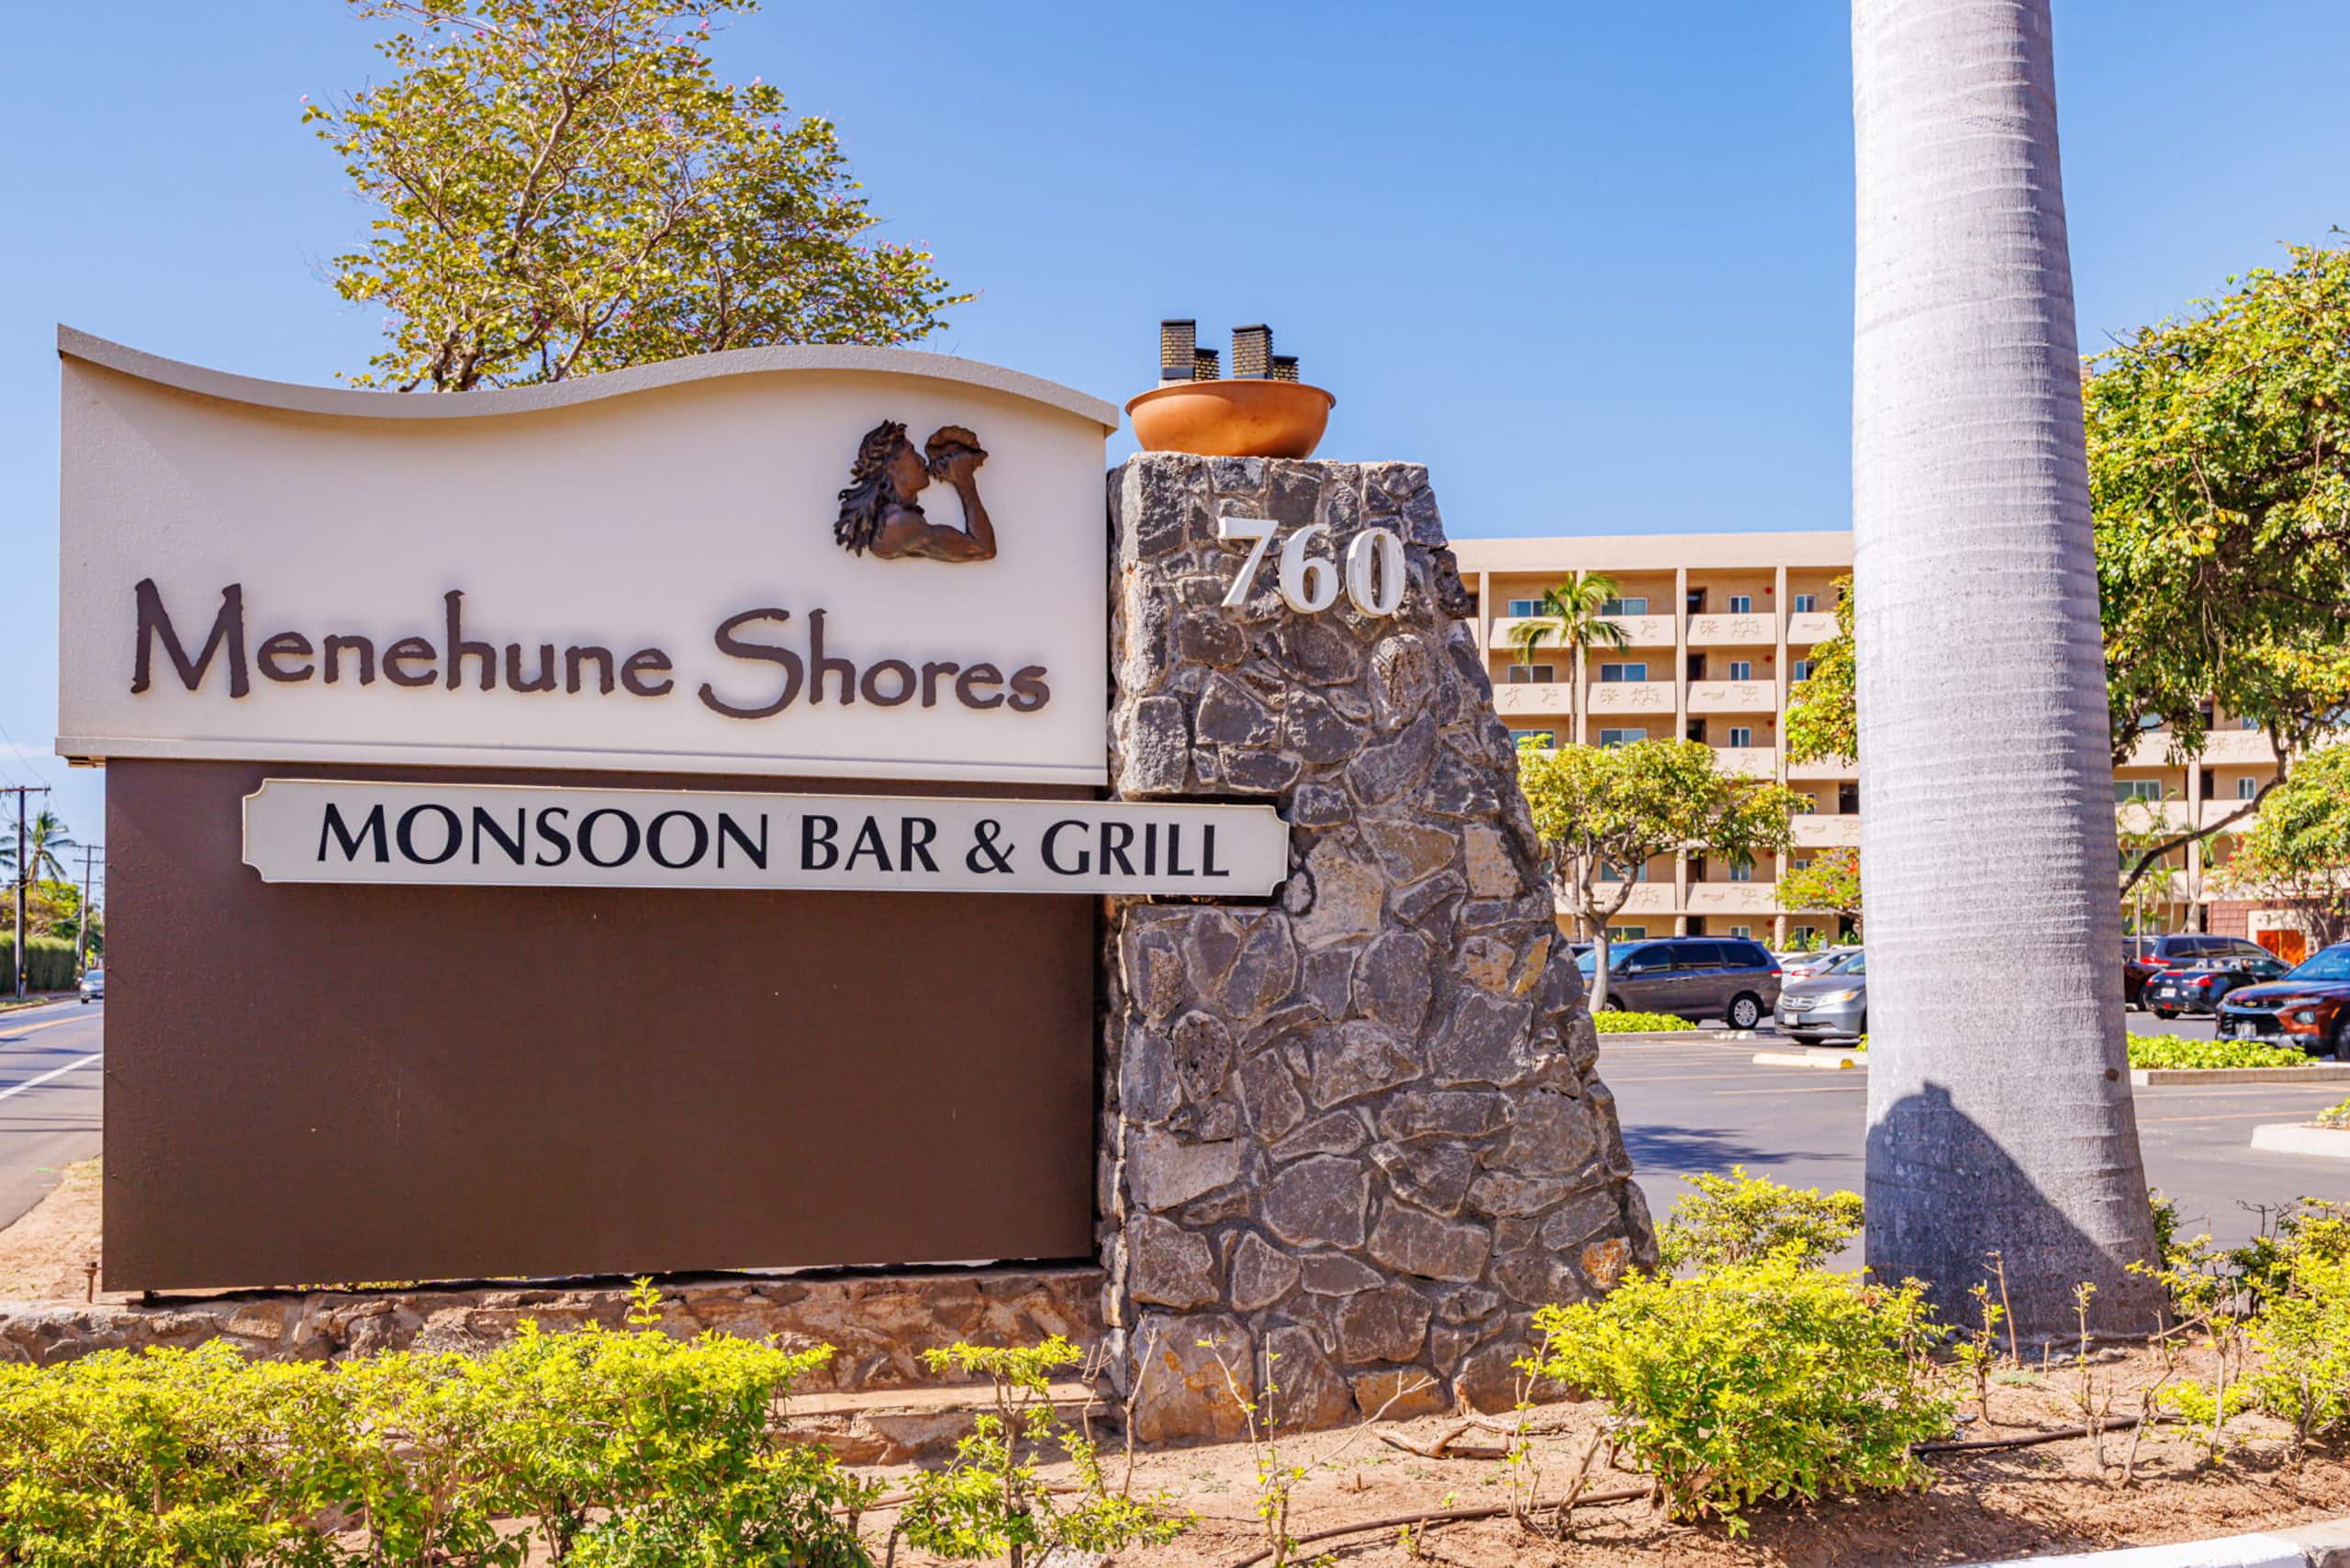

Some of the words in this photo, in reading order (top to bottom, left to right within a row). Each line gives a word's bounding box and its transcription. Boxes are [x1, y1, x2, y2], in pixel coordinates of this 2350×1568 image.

[1218, 517, 1406, 618] 760
[129, 577, 675, 699] Menehune
[698, 608, 1051, 720] Shores
[317, 802, 768, 870] MONSOON
[800, 814, 940, 873] BAR
[965, 819, 1015, 875] &
[1040, 819, 1230, 877] GRILL
